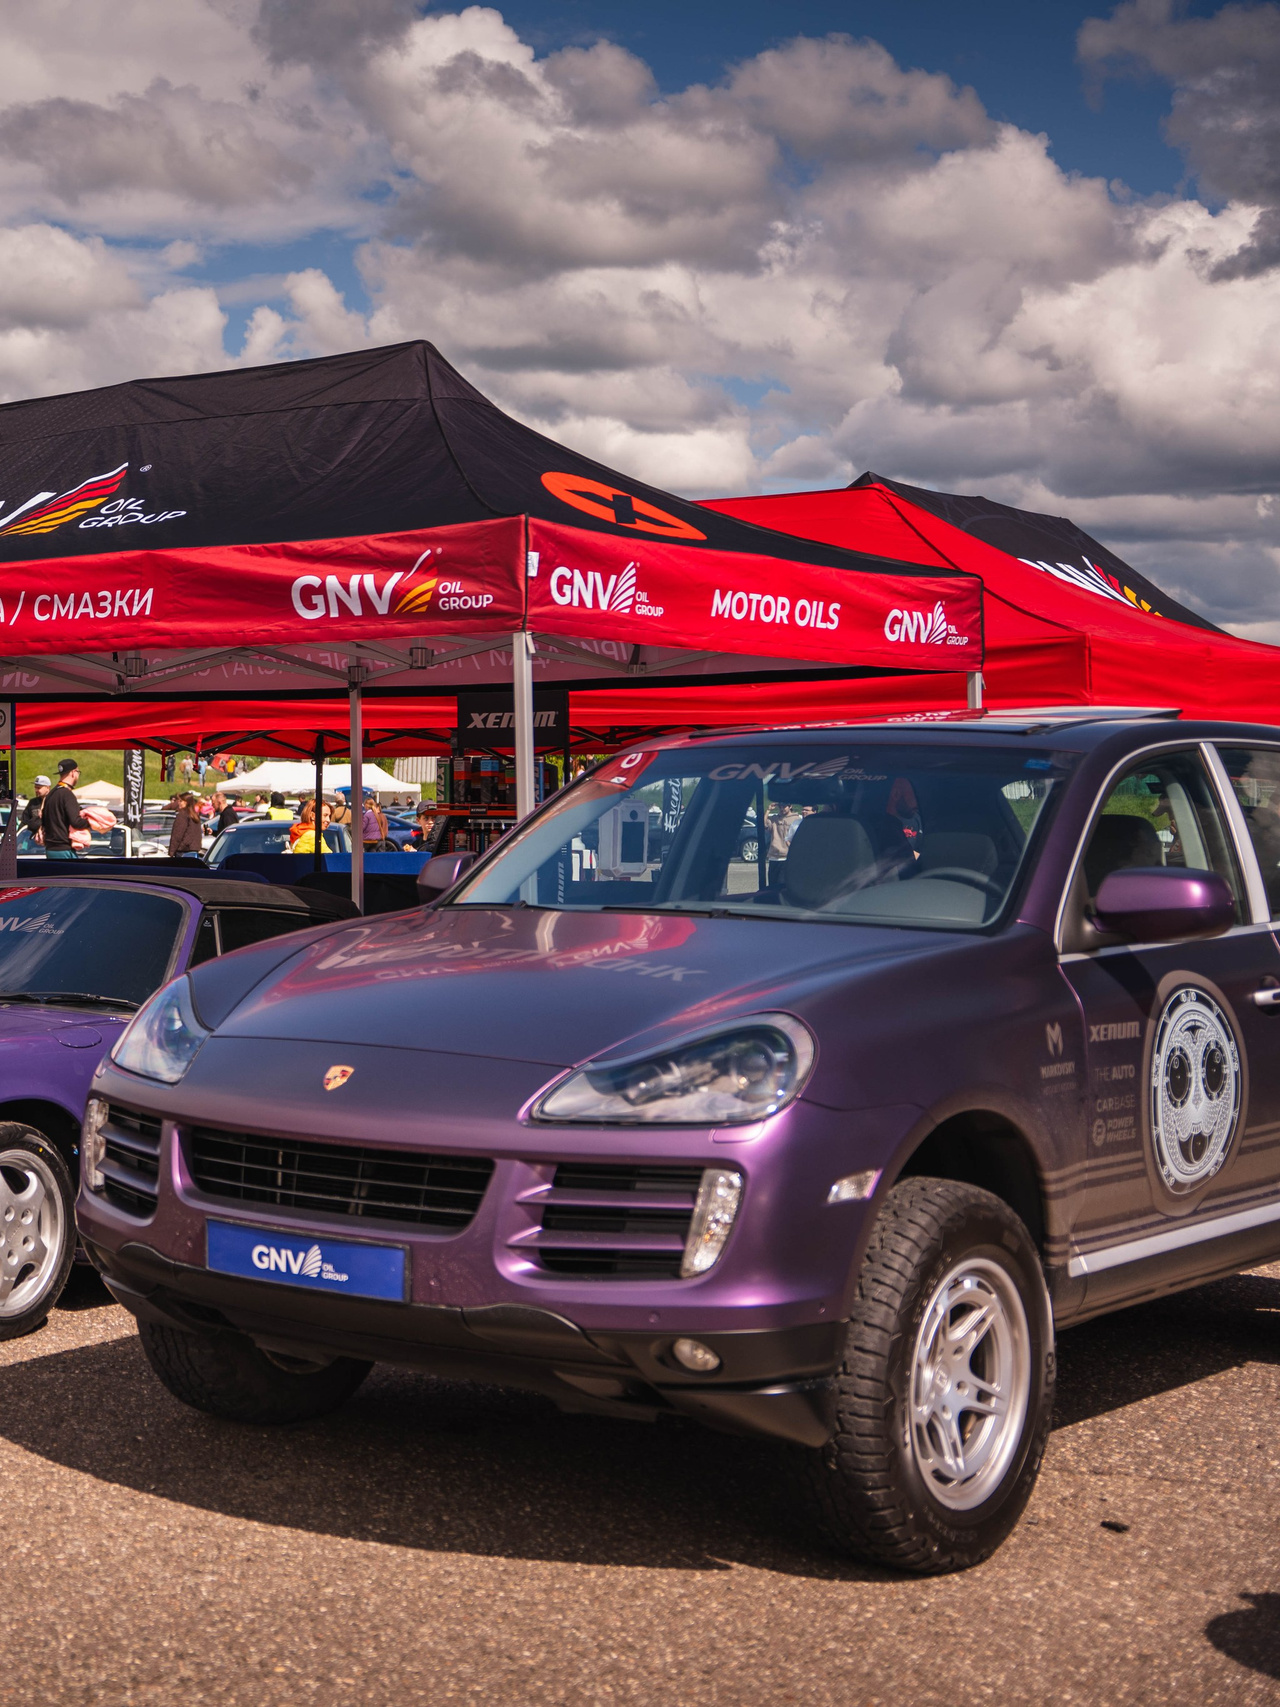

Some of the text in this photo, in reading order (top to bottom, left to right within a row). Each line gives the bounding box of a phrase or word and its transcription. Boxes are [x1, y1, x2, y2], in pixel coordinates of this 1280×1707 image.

[100, 497, 146, 514] OIL
[78, 511, 188, 529] GROUP
[291, 571, 404, 620] GNV
[438, 581, 465, 595] OIL
[550, 566, 618, 611] GNV
[32, 587, 155, 622] СМАЗКИ
[438, 594, 494, 611] GROUP
[635, 591, 650, 603] OIL
[635, 604, 664, 617] GROUP
[710, 588, 841, 631] MOTOR OILS
[884, 608, 932, 645] GNV
[947, 624, 959, 635] OIL
[946, 635, 969, 646] GROUP
[466, 710, 557, 729] XENM
[709, 761, 817, 781] GNV
[838, 774, 888, 782] GROUP
[843, 767, 865, 775] OIL
[1089, 1021, 1141, 1043] XENUM
[1094, 1064, 1136, 1082] THE AUTO
[1106, 1116, 1135, 1131] POWER
[1106, 1128, 1137, 1144] WHEELS
[251, 1244, 306, 1275] GNV
[321, 1262, 335, 1273] OIL
[320, 1271, 350, 1283] GROUP
